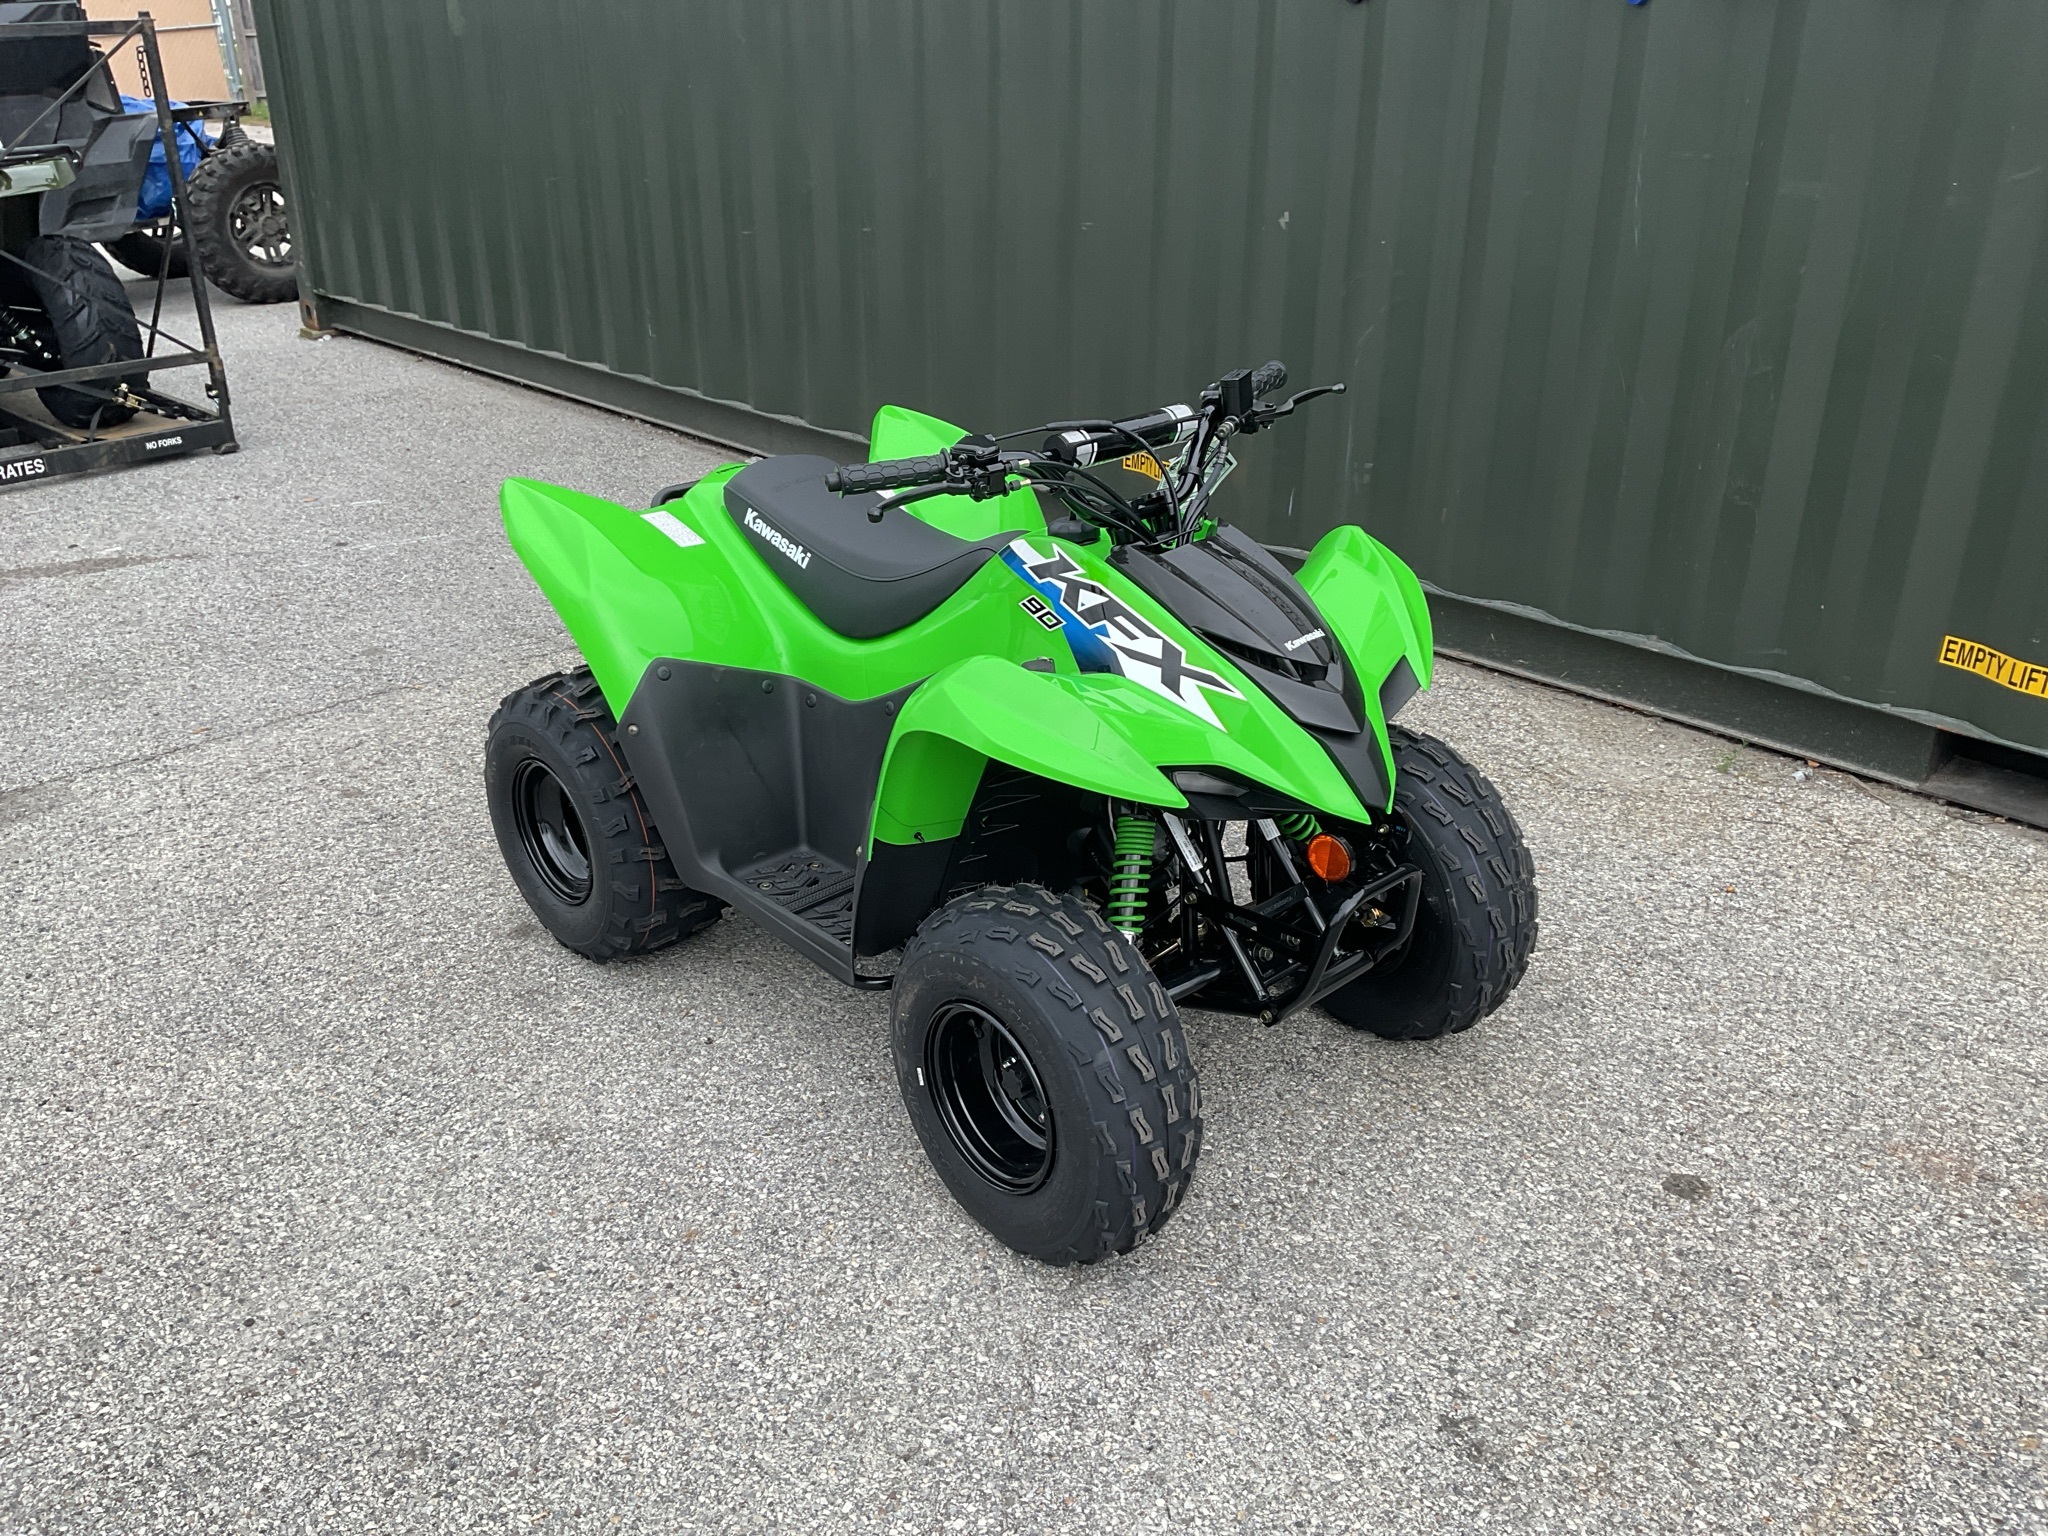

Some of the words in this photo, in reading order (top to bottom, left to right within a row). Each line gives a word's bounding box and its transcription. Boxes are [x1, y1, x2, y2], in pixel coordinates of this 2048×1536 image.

[145, 441, 158, 450] NO
[158, 436, 183, 448] FORKS
[743, 507, 812, 570] Kawasaki
[1020, 595, 1066, 631] 90
[1023, 544, 1243, 703] KFX
[1283, 627, 1326, 652] Kawasaki
[1942, 638, 2008, 680] EMPTY
